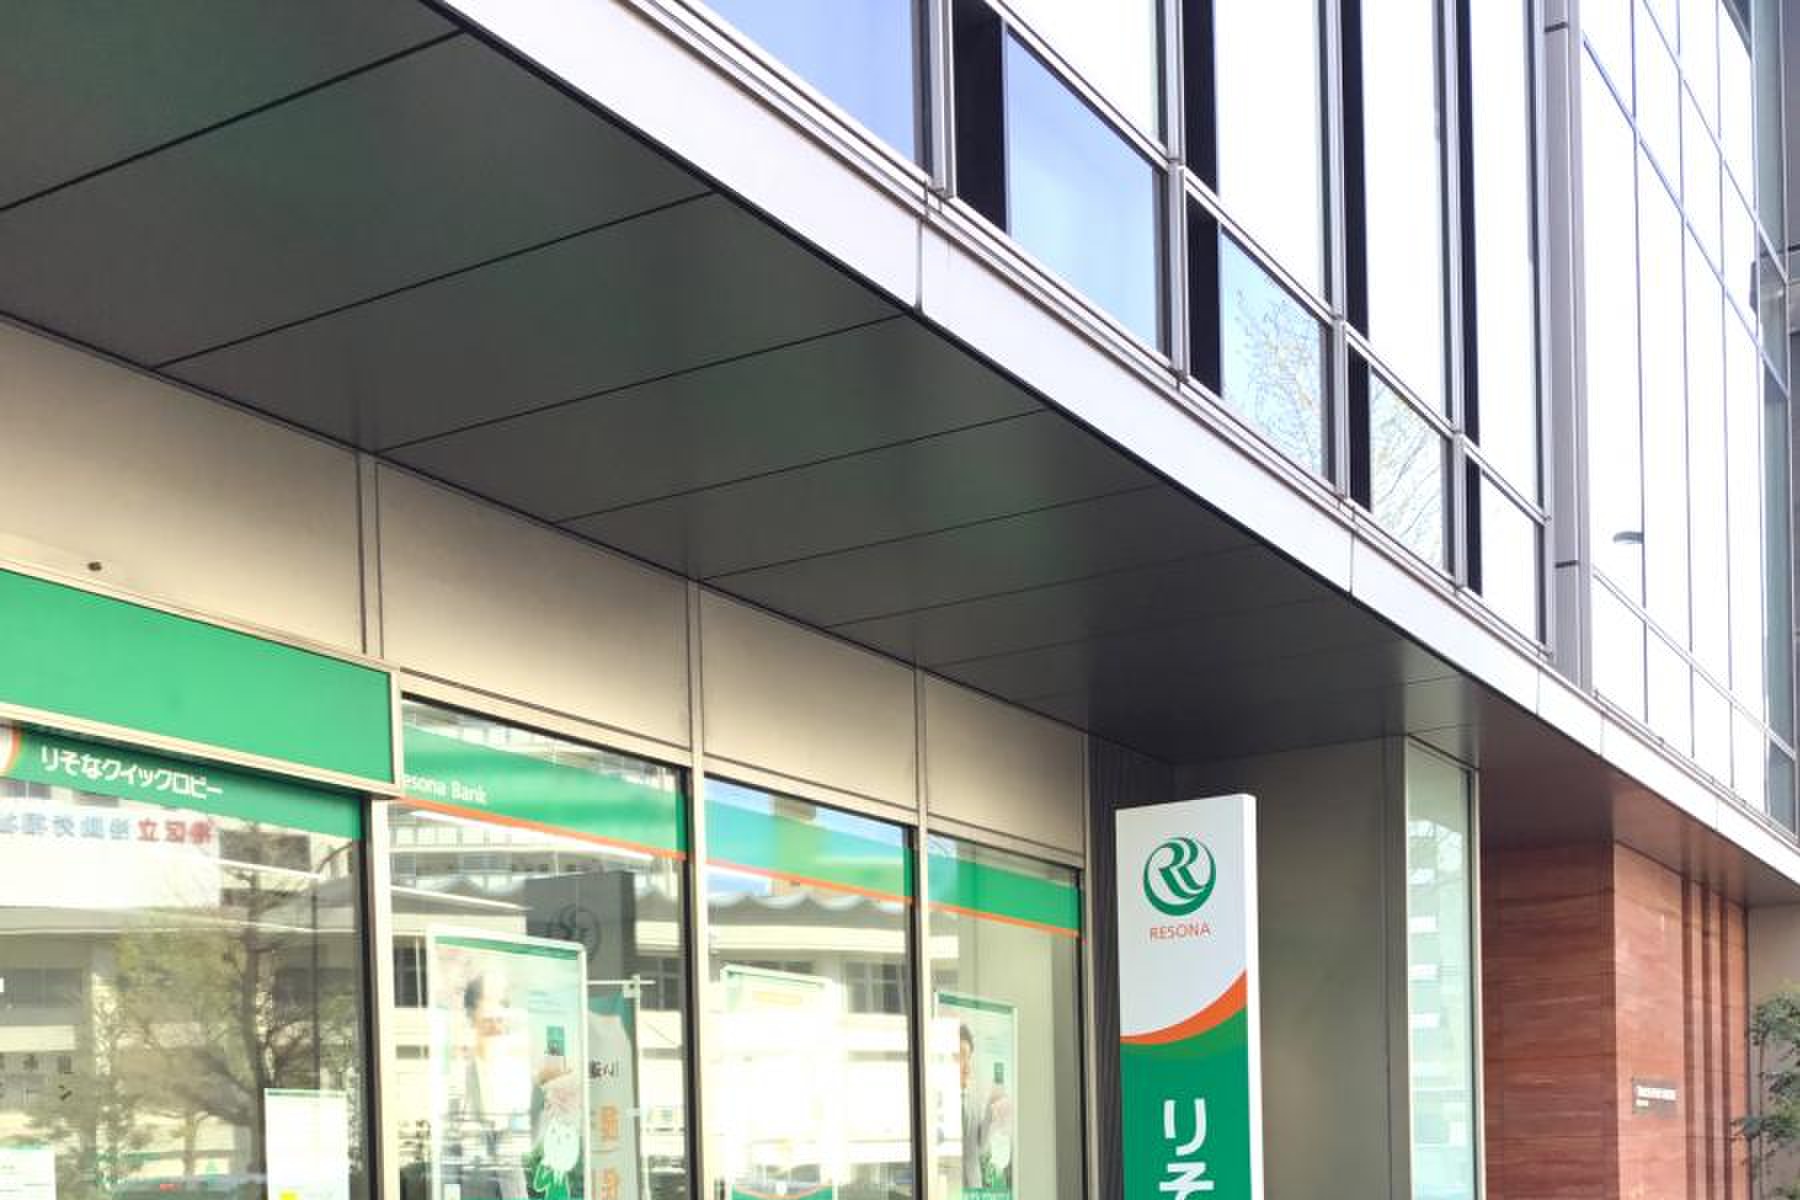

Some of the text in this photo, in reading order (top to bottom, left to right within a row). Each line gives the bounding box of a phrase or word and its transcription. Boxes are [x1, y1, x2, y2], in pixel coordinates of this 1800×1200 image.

[40, 745, 224, 801] りそなクイックロビー
[403, 773, 487, 804] esona Bank
[1149, 923, 1211, 940] RESONA
